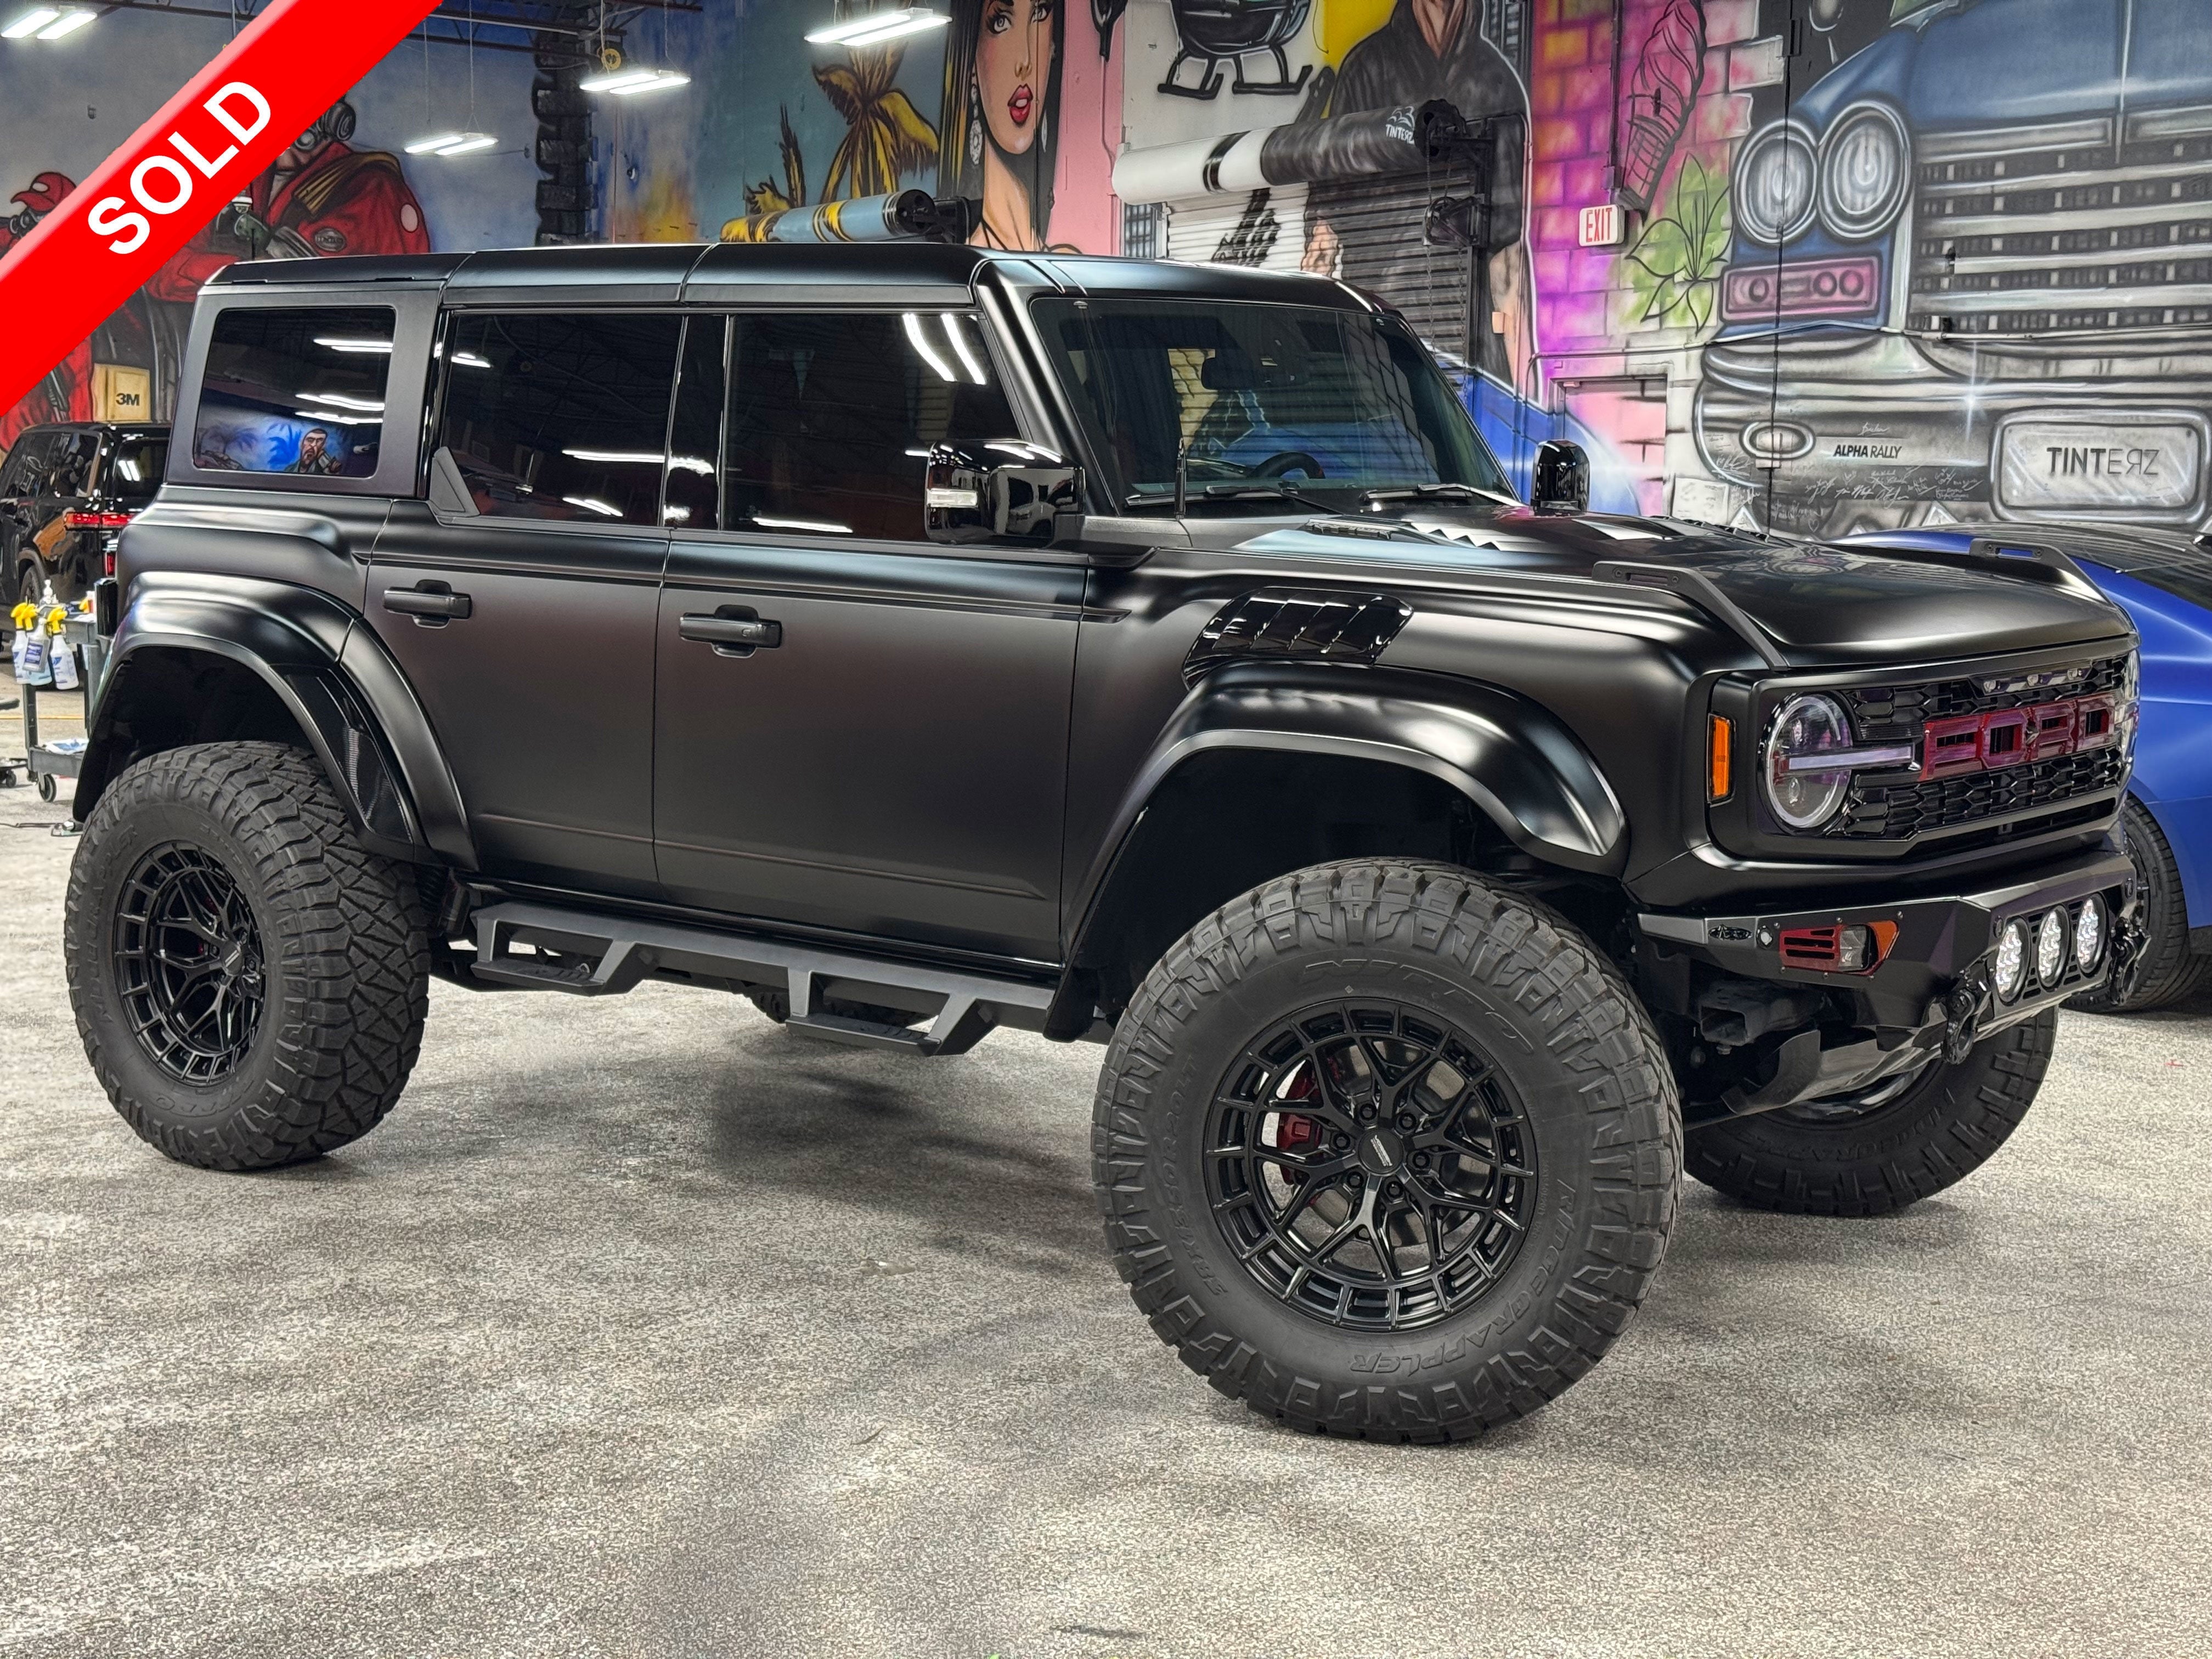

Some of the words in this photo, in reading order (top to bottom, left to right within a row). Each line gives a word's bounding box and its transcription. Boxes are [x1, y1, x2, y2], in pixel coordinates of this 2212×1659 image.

[1585, 207, 1612, 242] EXIT
[115, 393, 140, 407] 3M
[1833, 444, 1869, 458] ALPHA
[1870, 445, 1902, 459] RALLY
[1918, 691, 2117, 782] FORD
[1530, 1178, 1577, 1298] RIDGE
[1347, 1290, 1531, 1378] GRAPPLER
